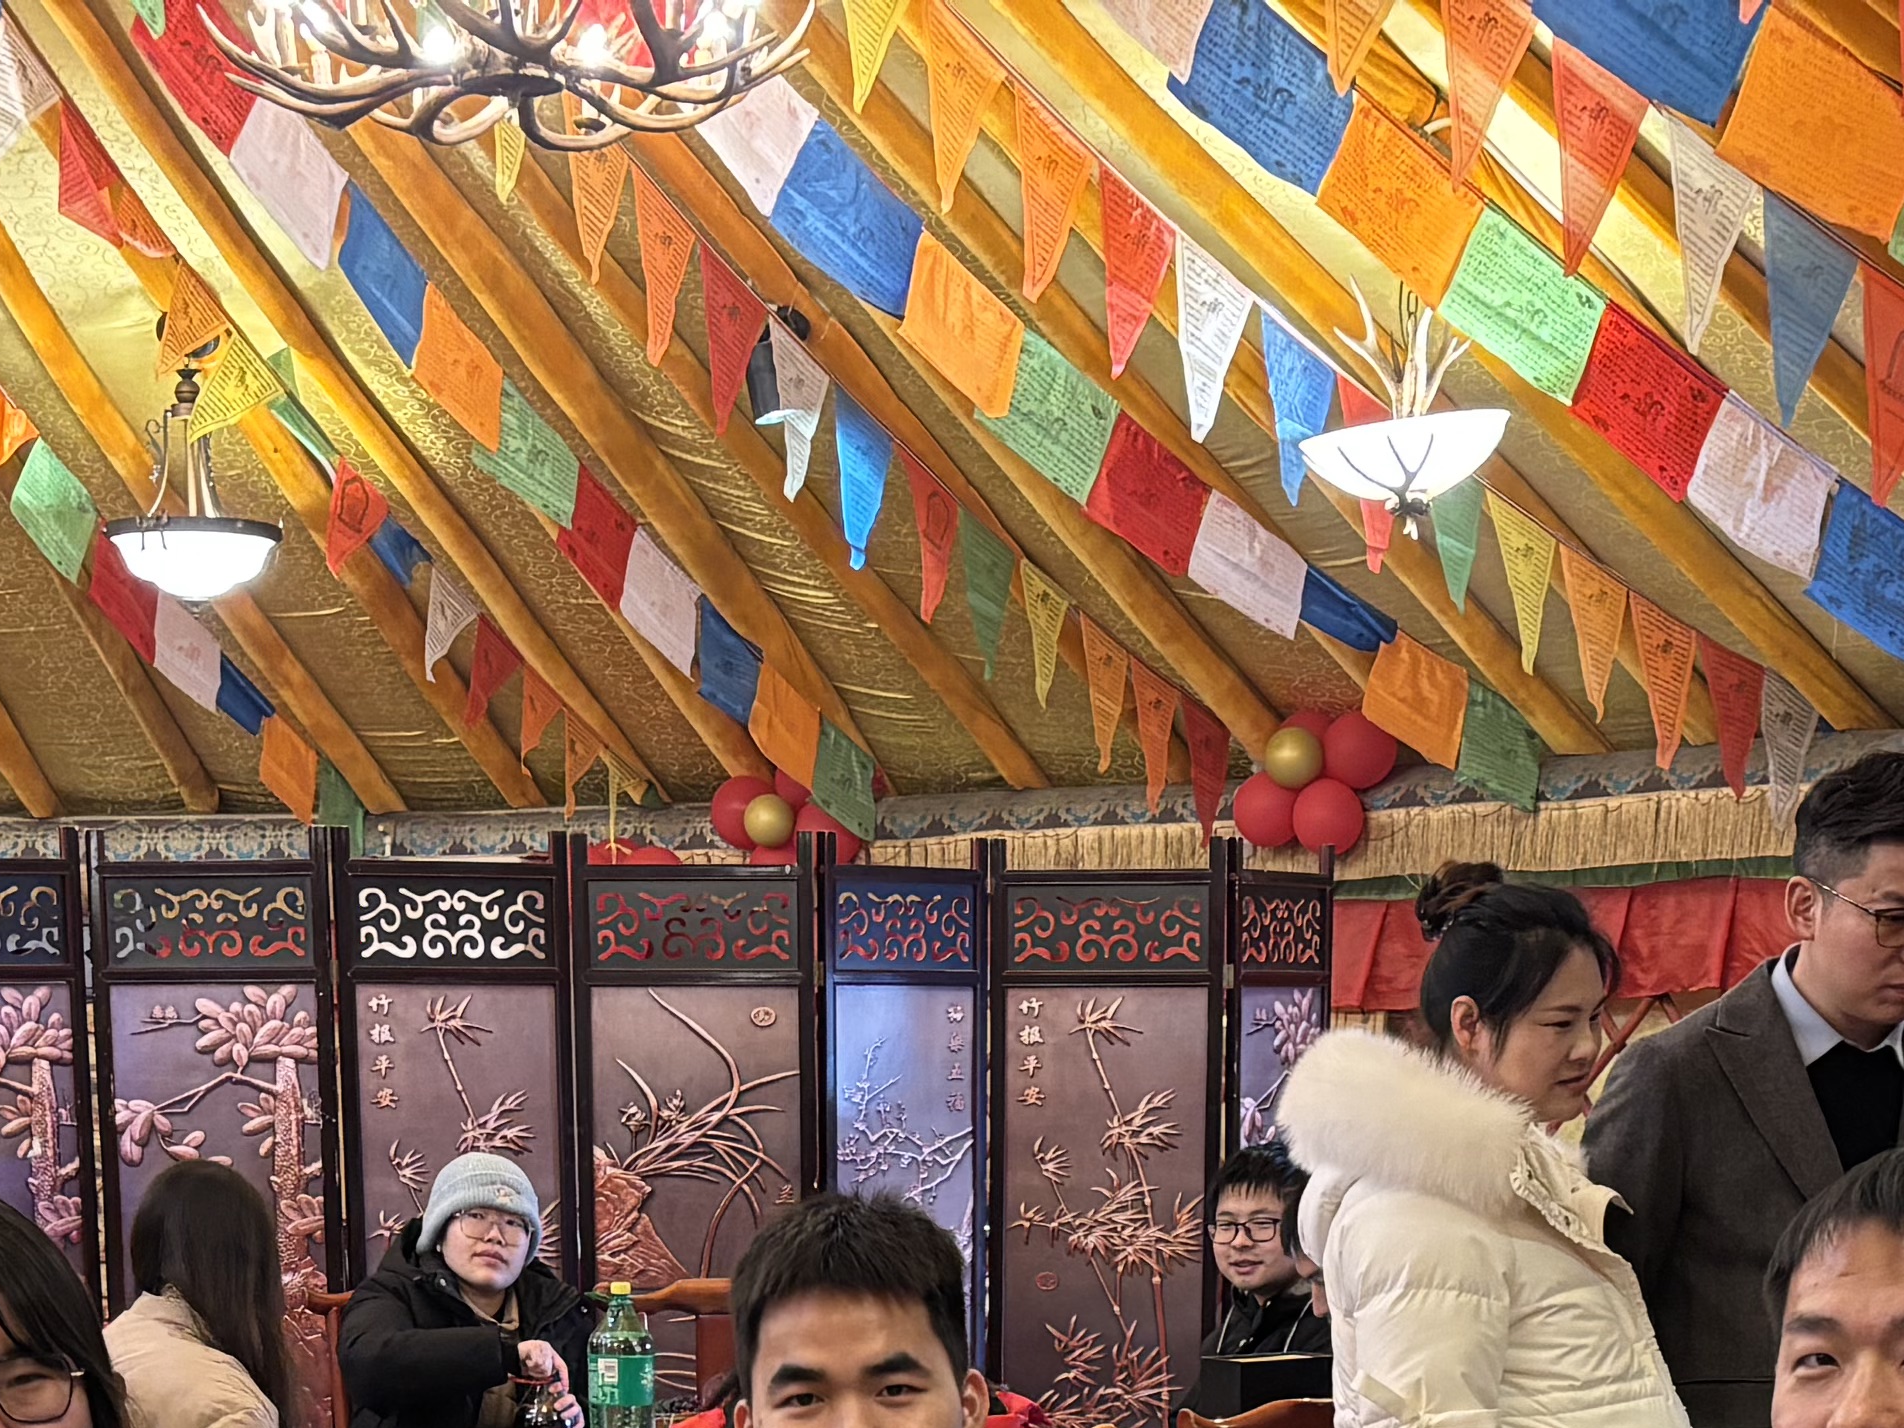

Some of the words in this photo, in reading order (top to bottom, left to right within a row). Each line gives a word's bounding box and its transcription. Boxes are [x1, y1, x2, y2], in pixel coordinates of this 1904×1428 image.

[368, 993, 399, 1109] 竹报平安
[1017, 997, 1046, 1106] 竹报平安
